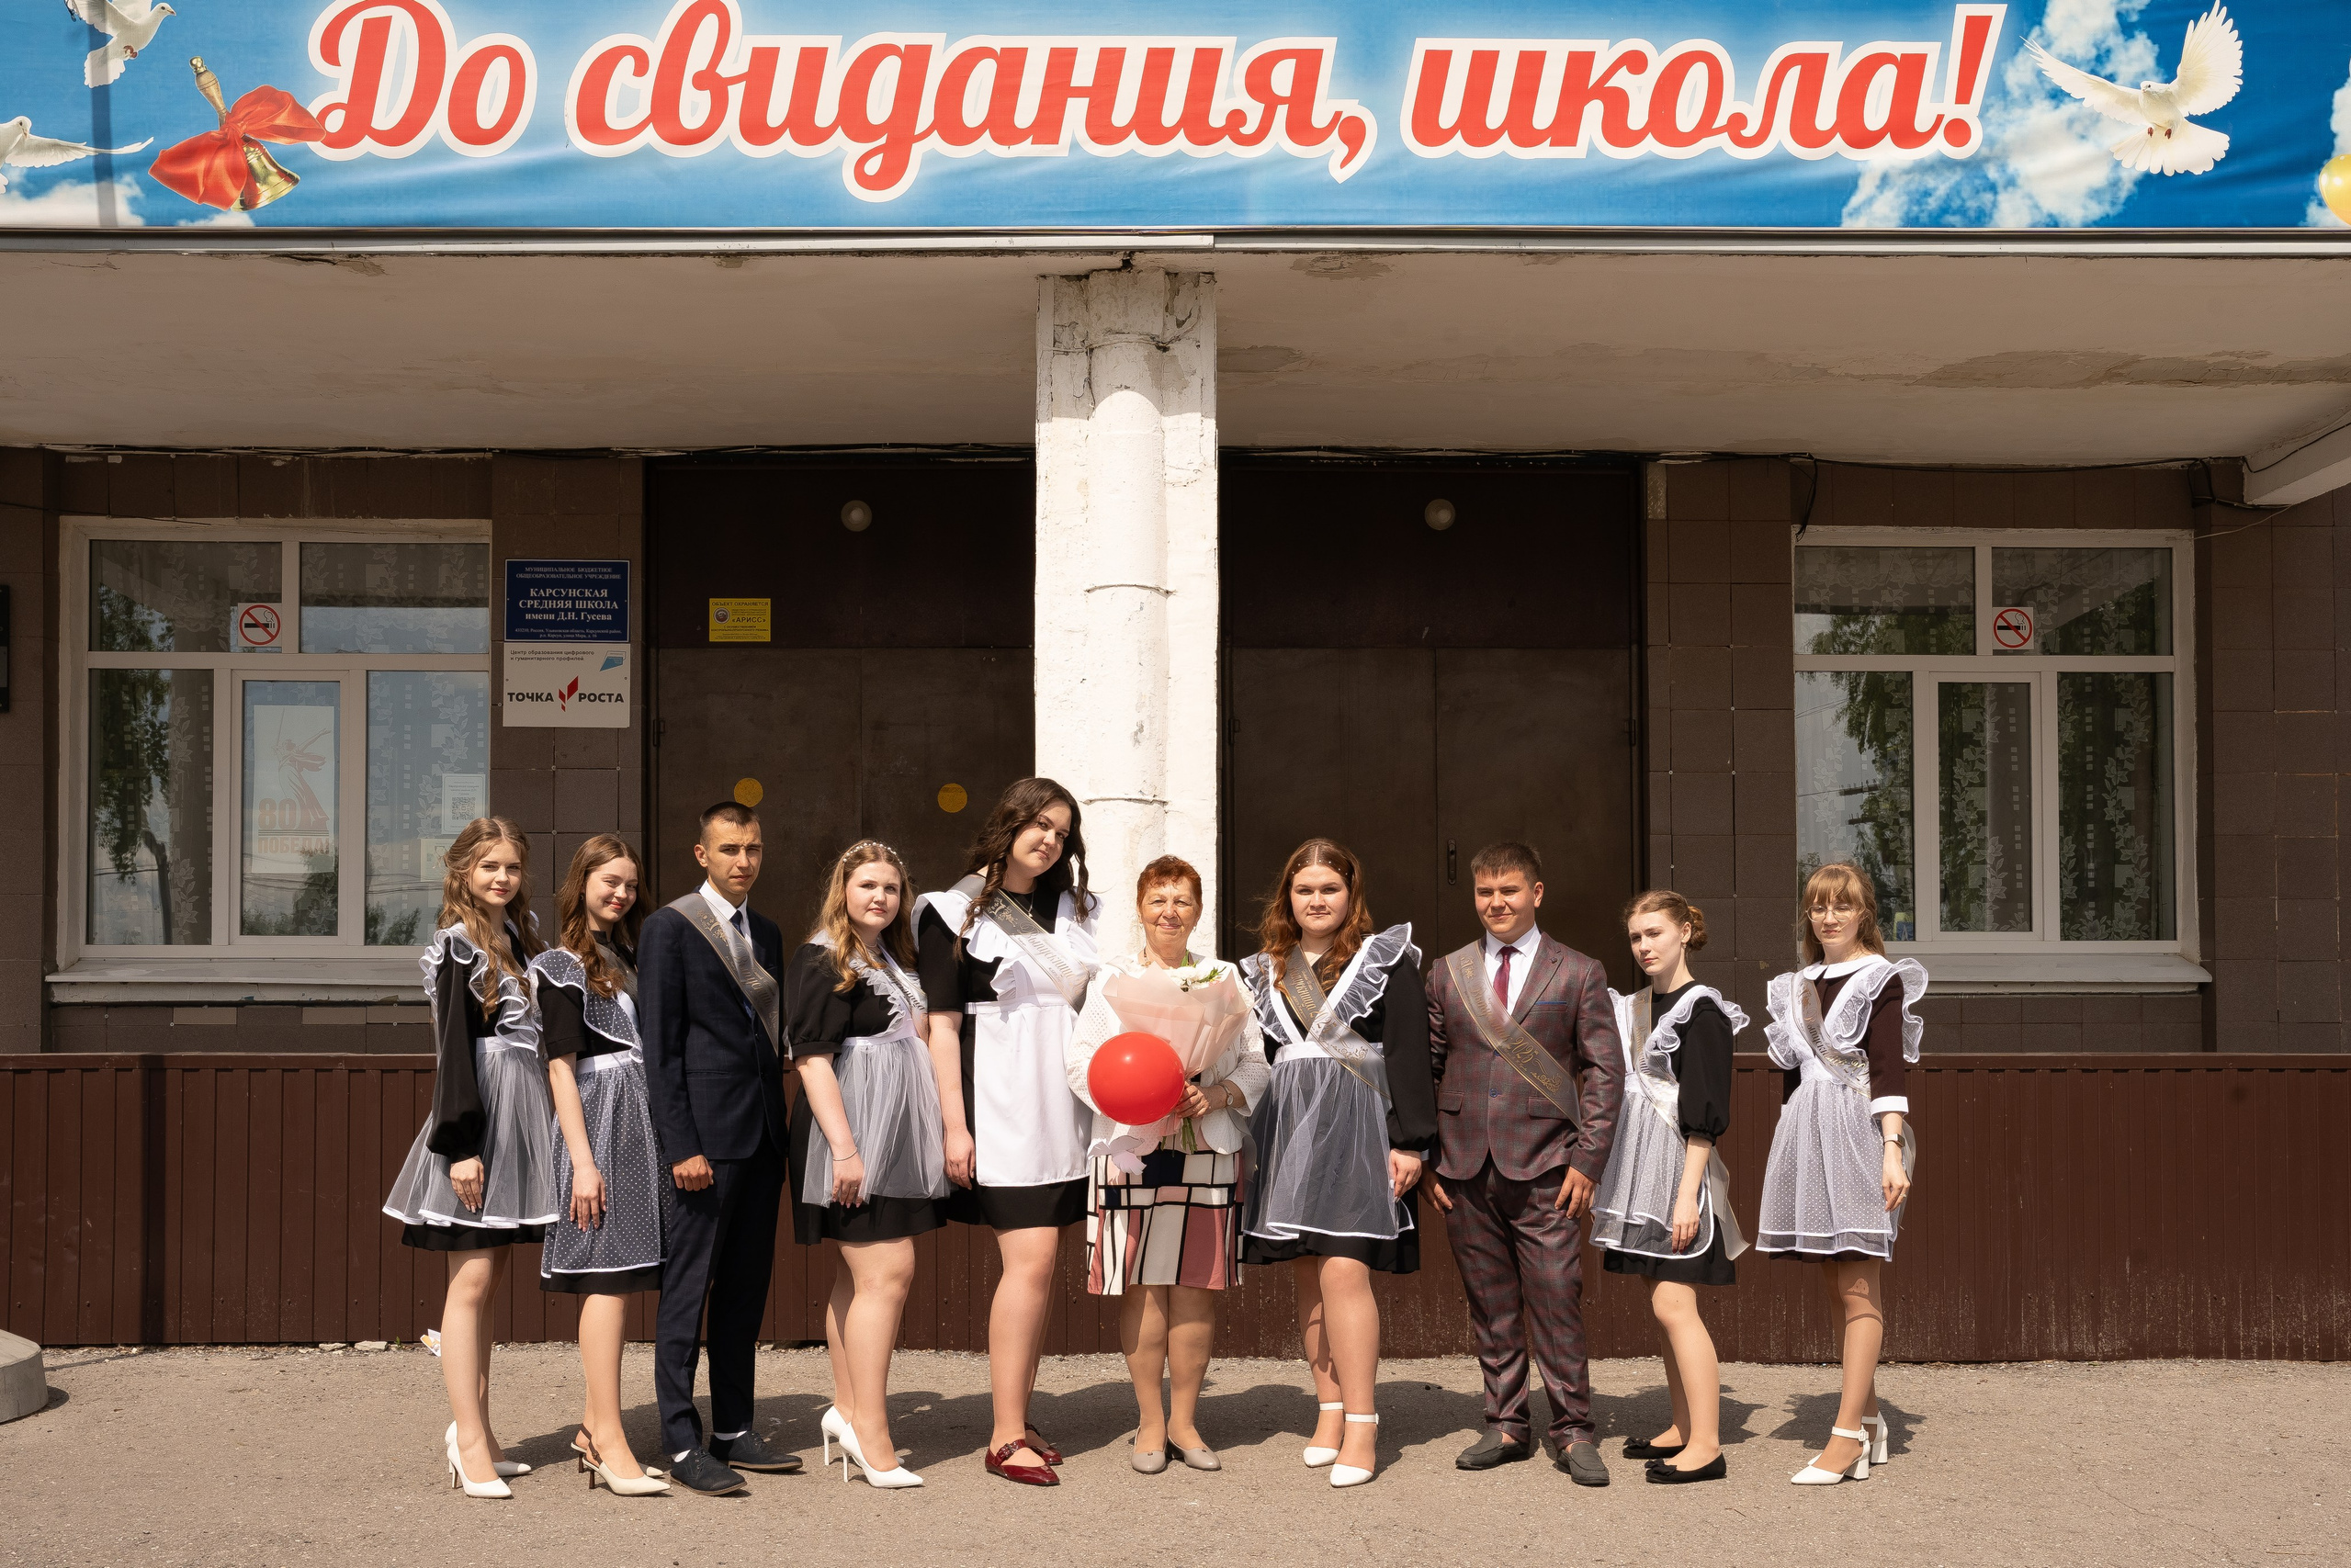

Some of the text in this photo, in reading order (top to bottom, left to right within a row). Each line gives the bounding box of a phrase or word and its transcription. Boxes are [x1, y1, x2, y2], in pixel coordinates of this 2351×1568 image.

[312, 0, 1994, 191] До свидания, школа!
[530, 588, 608, 597] КАРСУНСКАЯ
[518, 599, 618, 609] СРЕДНЯЯ ШКОЛА
[557, 612, 578, 621] Д.Н.
[581, 612, 612, 622] Гусева
[507, 692, 624, 703] ТОЧКА РОСТА
[258, 797, 297, 829] 80
[1506, 1035, 1539, 1063] 2025
